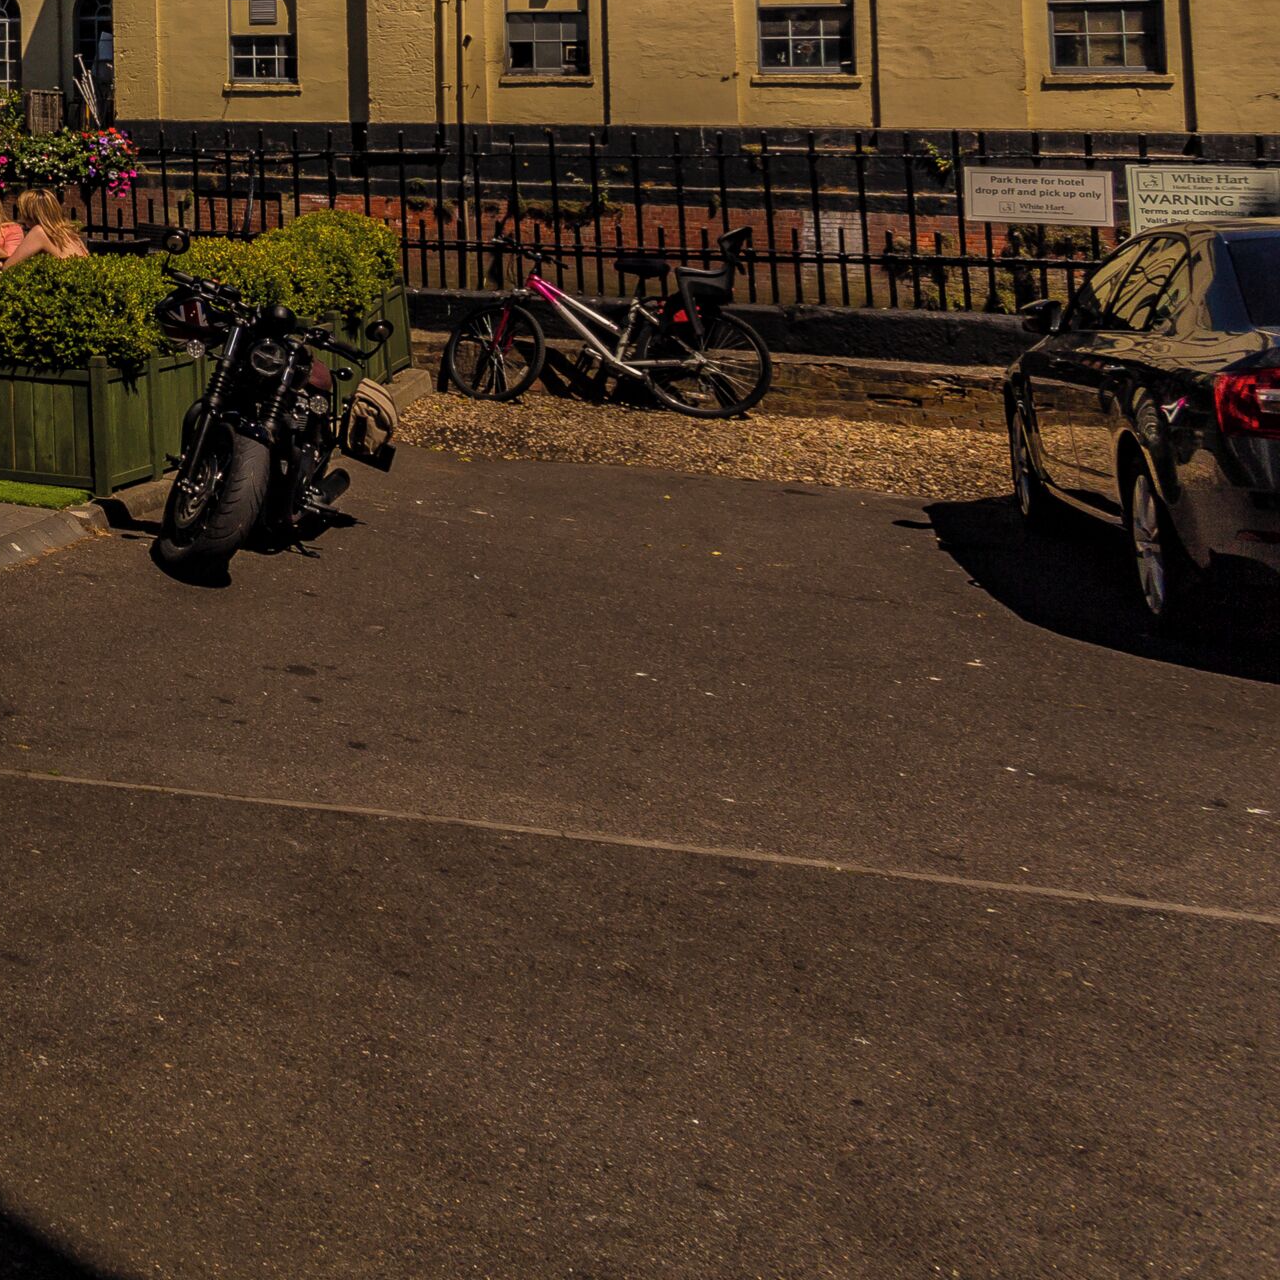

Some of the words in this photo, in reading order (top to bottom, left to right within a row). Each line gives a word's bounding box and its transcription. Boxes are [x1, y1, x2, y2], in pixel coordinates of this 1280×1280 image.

[990, 176, 1013, 184] Park
[1015, 176, 1039, 185] here
[1040, 177, 1055, 186] for
[1057, 178, 1085, 186] hotel
[1171, 174, 1214, 184] White
[1217, 174, 1249, 185] Hart
[975, 187, 999, 196] drop
[1017, 188, 1037, 196] and
[1039, 189, 1061, 198] pick
[1062, 191, 1076, 199] up
[1078, 191, 1102, 200] only
[1138, 194, 1234, 207] WARNING
[1019, 202, 1044, 210] White
[1046, 203, 1065, 211] Hart
[1140, 207, 1169, 215] Terms
[1192, 208, 1245, 216] Conditions
